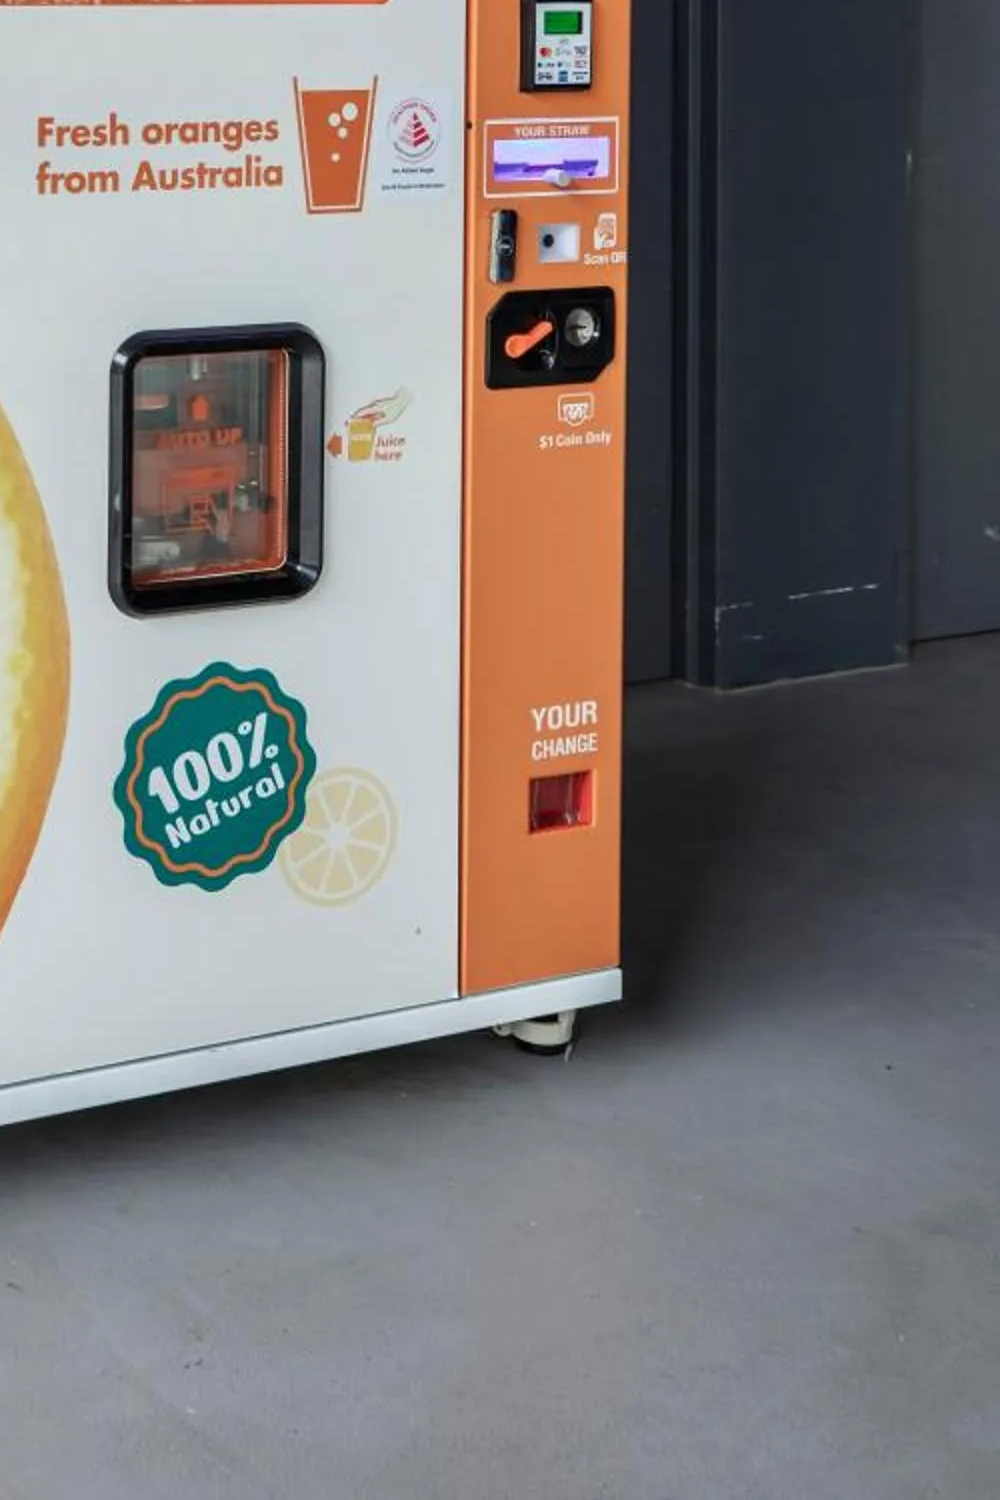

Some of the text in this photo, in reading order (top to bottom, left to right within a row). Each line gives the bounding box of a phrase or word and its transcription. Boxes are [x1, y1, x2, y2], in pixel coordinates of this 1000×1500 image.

[36, 112, 280, 152] Fresh oranges
[35, 154, 284, 195] from Australia
[531, 700, 599, 732] YOUR
[147, 711, 280, 814] 100%
[530, 732, 599, 761] CHANGE
[164, 761, 286, 849] Natural
